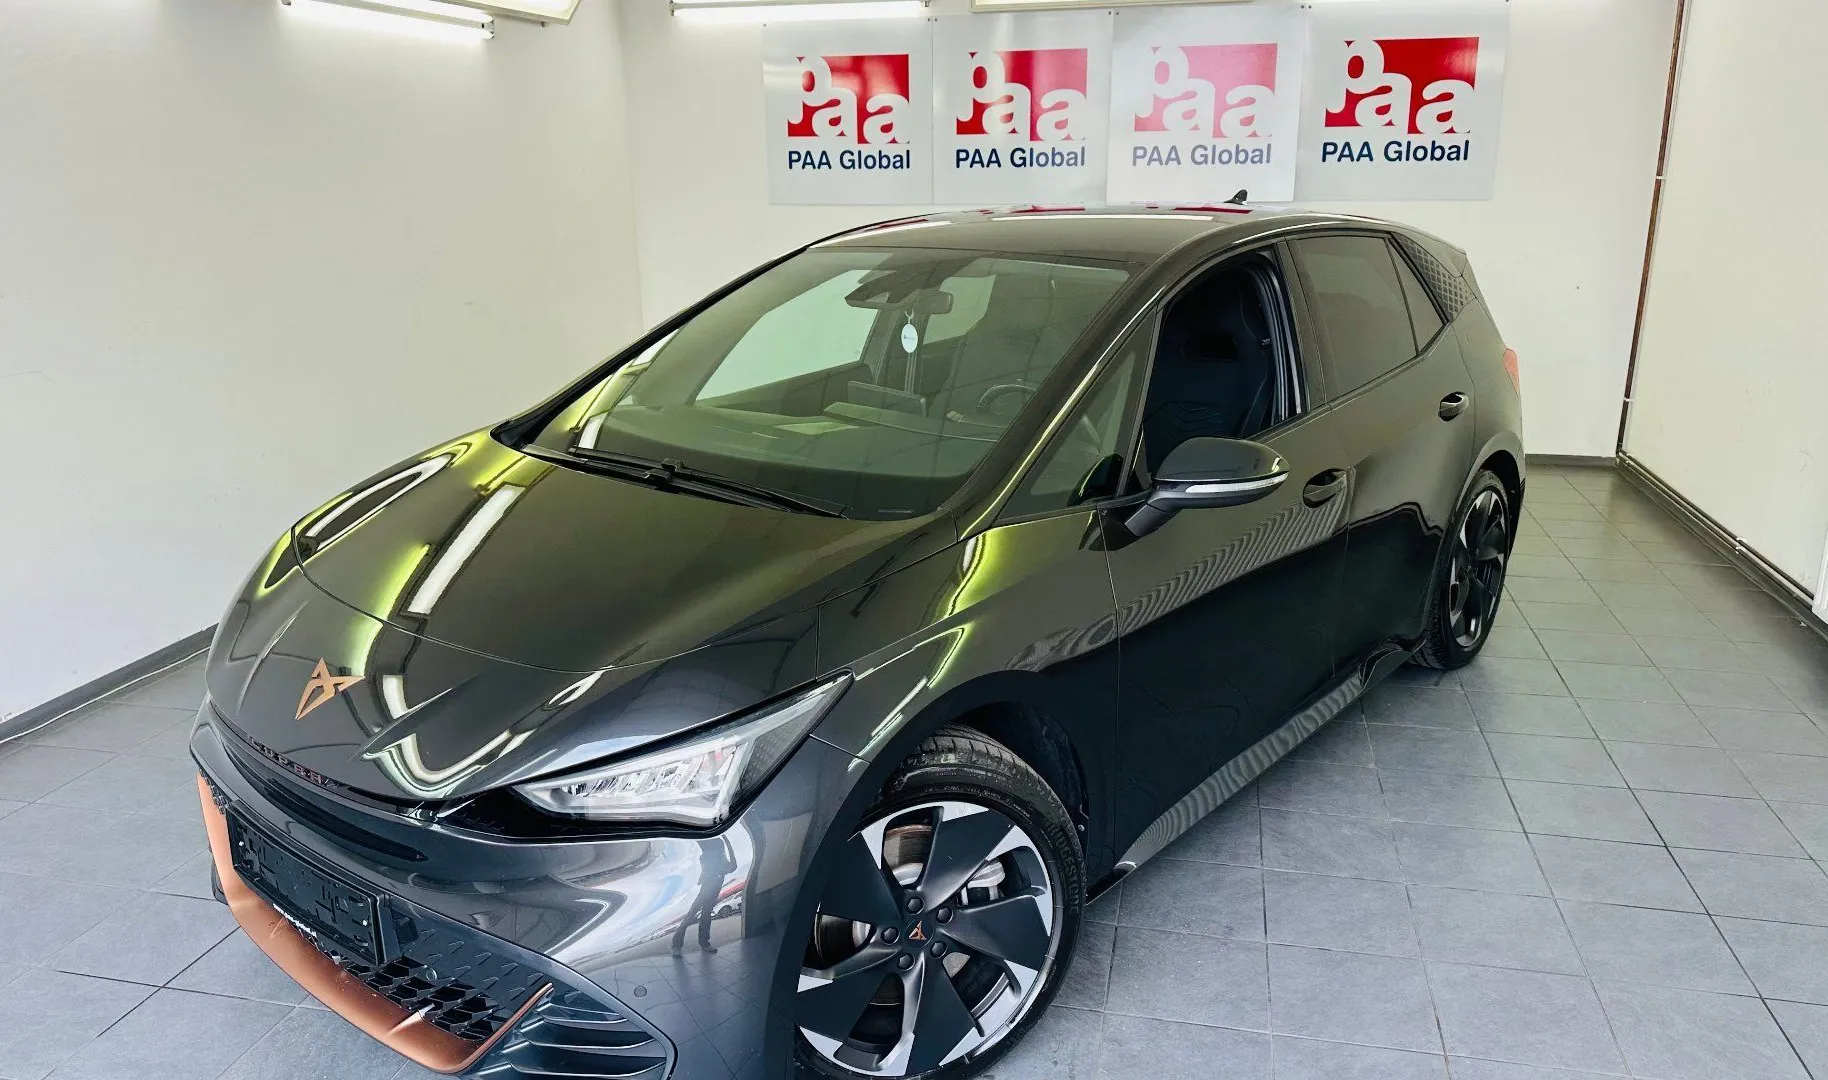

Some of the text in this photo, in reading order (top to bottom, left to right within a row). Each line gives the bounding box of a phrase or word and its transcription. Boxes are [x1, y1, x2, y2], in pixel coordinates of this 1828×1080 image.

[788, 149, 911, 169] PAA Global
[955, 146, 1085, 168] PAA Global
[1132, 143, 1272, 166] PAA Global
[1321, 139, 1470, 162] PAA Global
